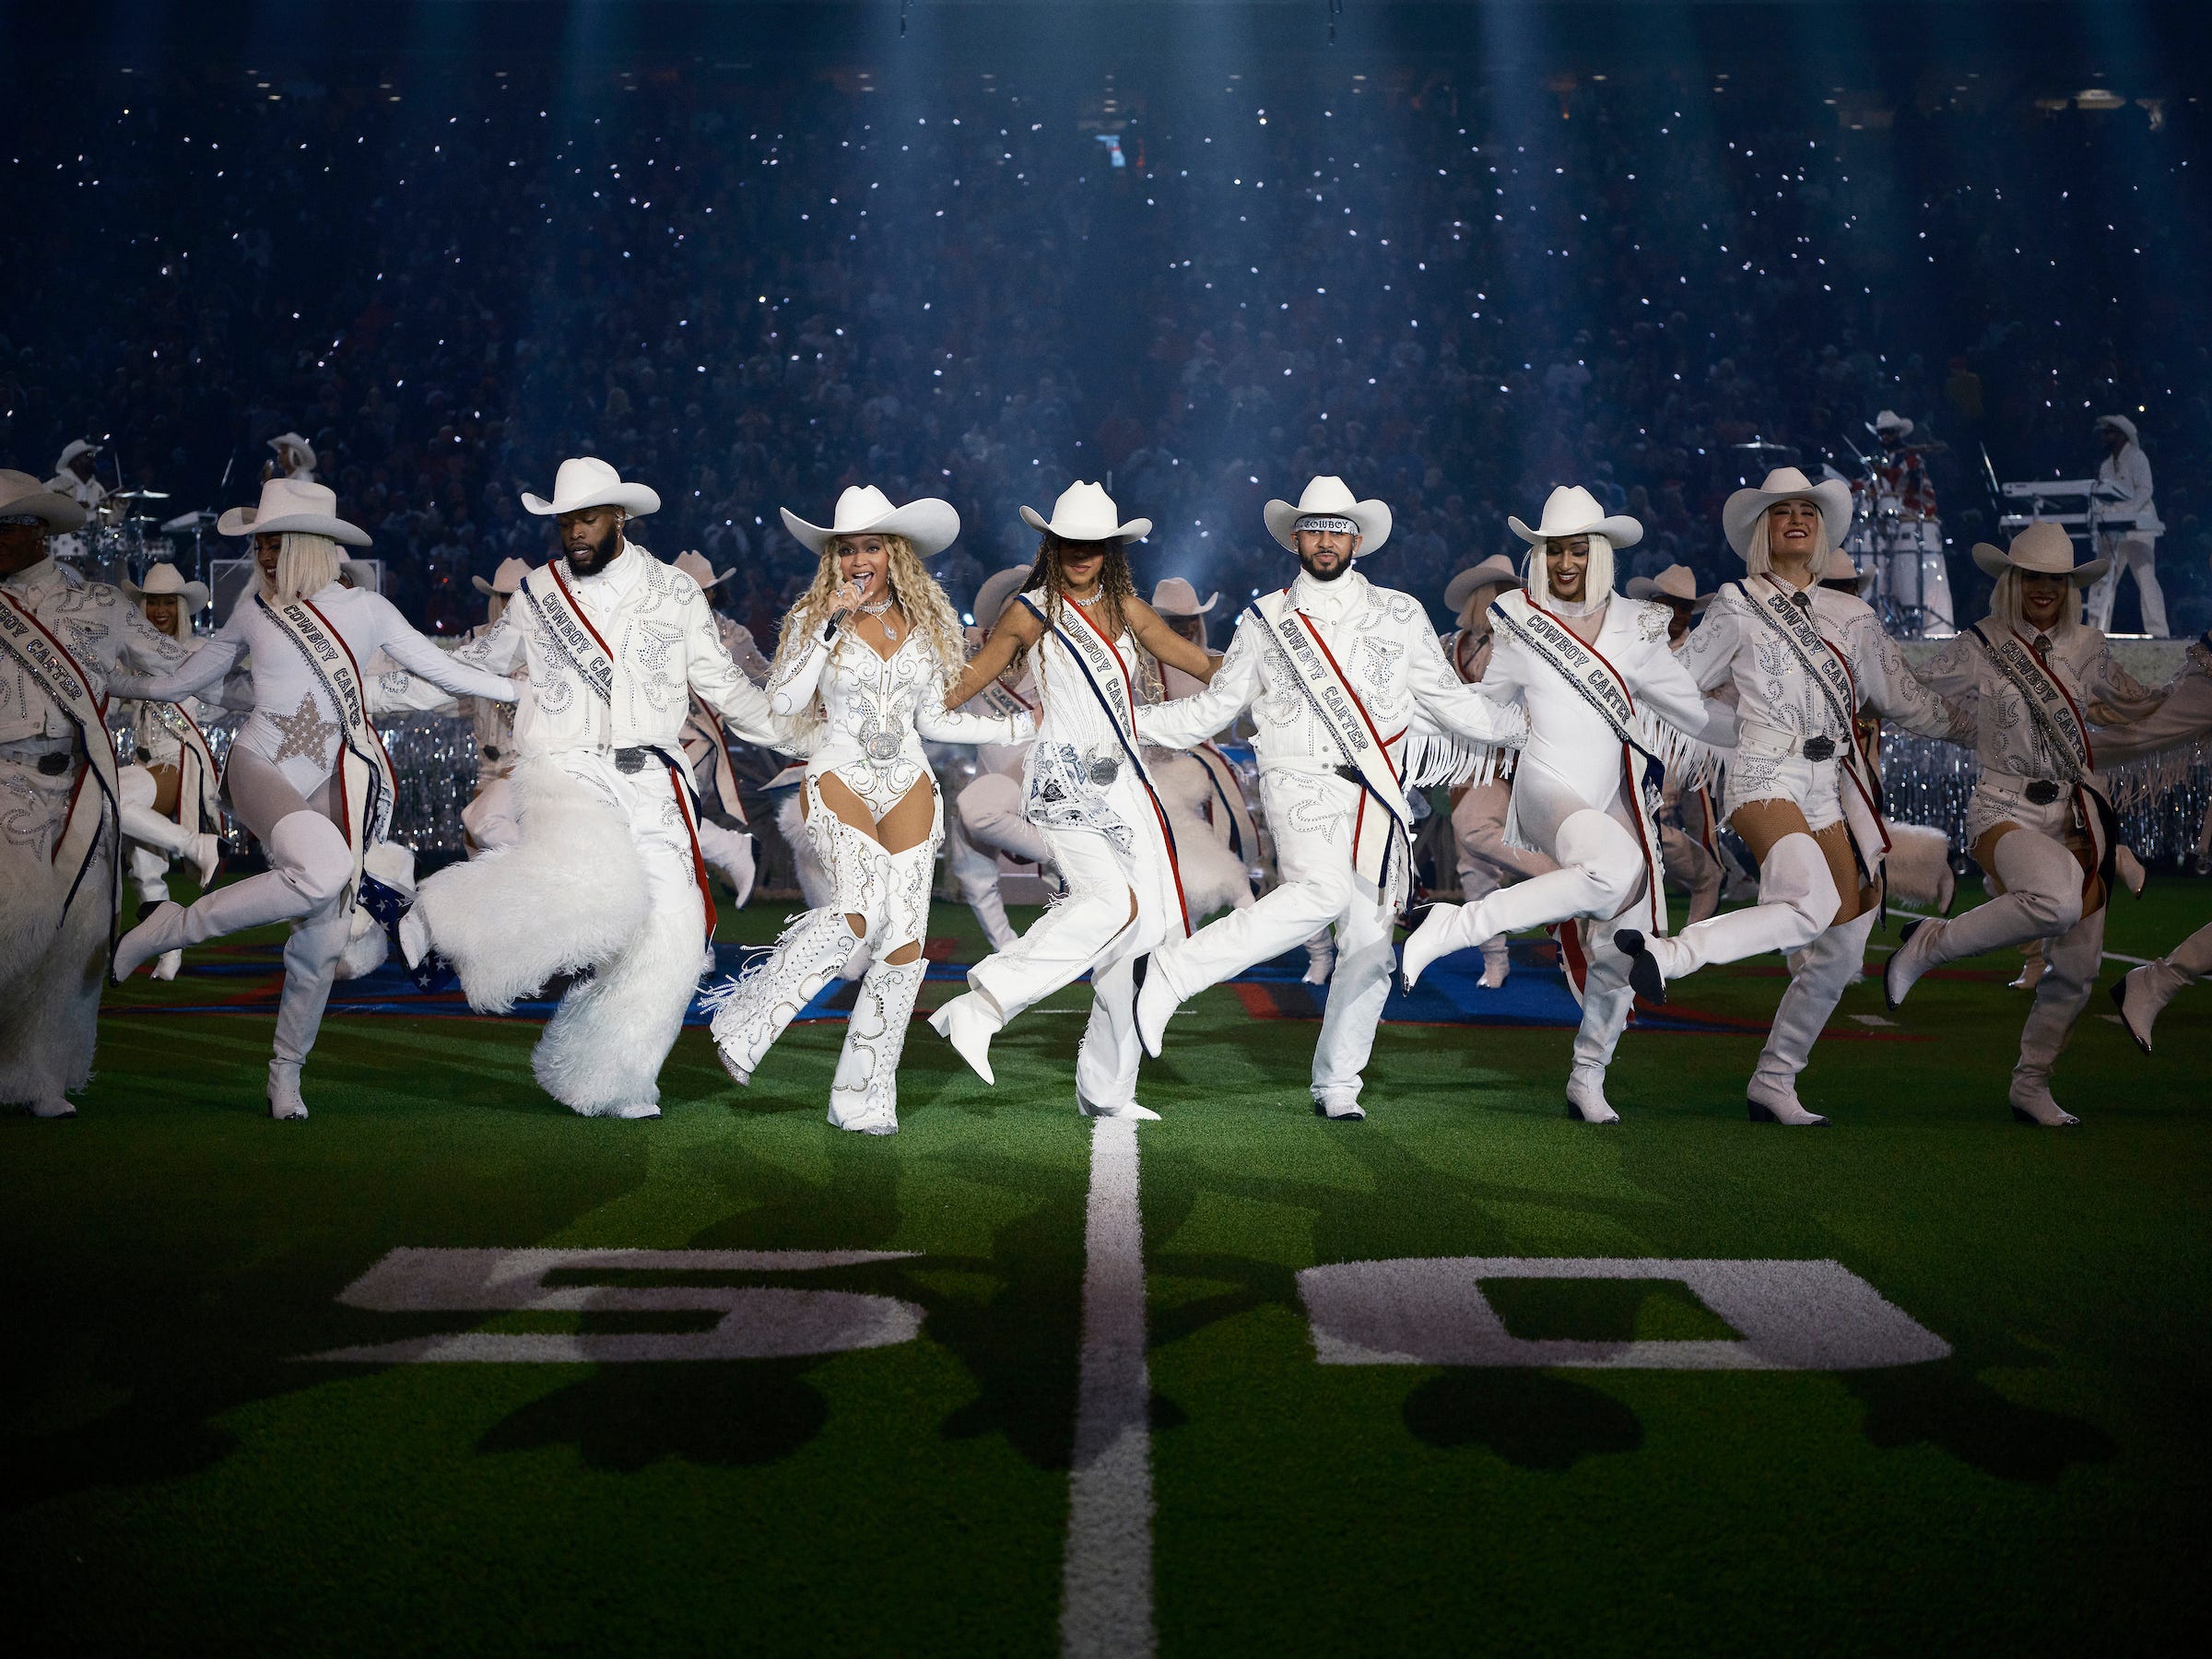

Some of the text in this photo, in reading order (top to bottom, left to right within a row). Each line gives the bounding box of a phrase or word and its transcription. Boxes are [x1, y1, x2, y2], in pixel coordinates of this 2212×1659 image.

[1304, 521, 1348, 529] COWBOY
[283, 605, 338, 662] COWBOY
[542, 592, 594, 653] COWBOY
[1061, 610, 1112, 672] COWBOY
[1768, 594, 1826, 656] COWBOY
[27, 639, 83, 700] CARTER
[1278, 618, 1370, 752] COWBOY CARTER
[1526, 614, 1631, 725] COWBOY CARTER
[2001, 640, 2059, 703] COWBOY
